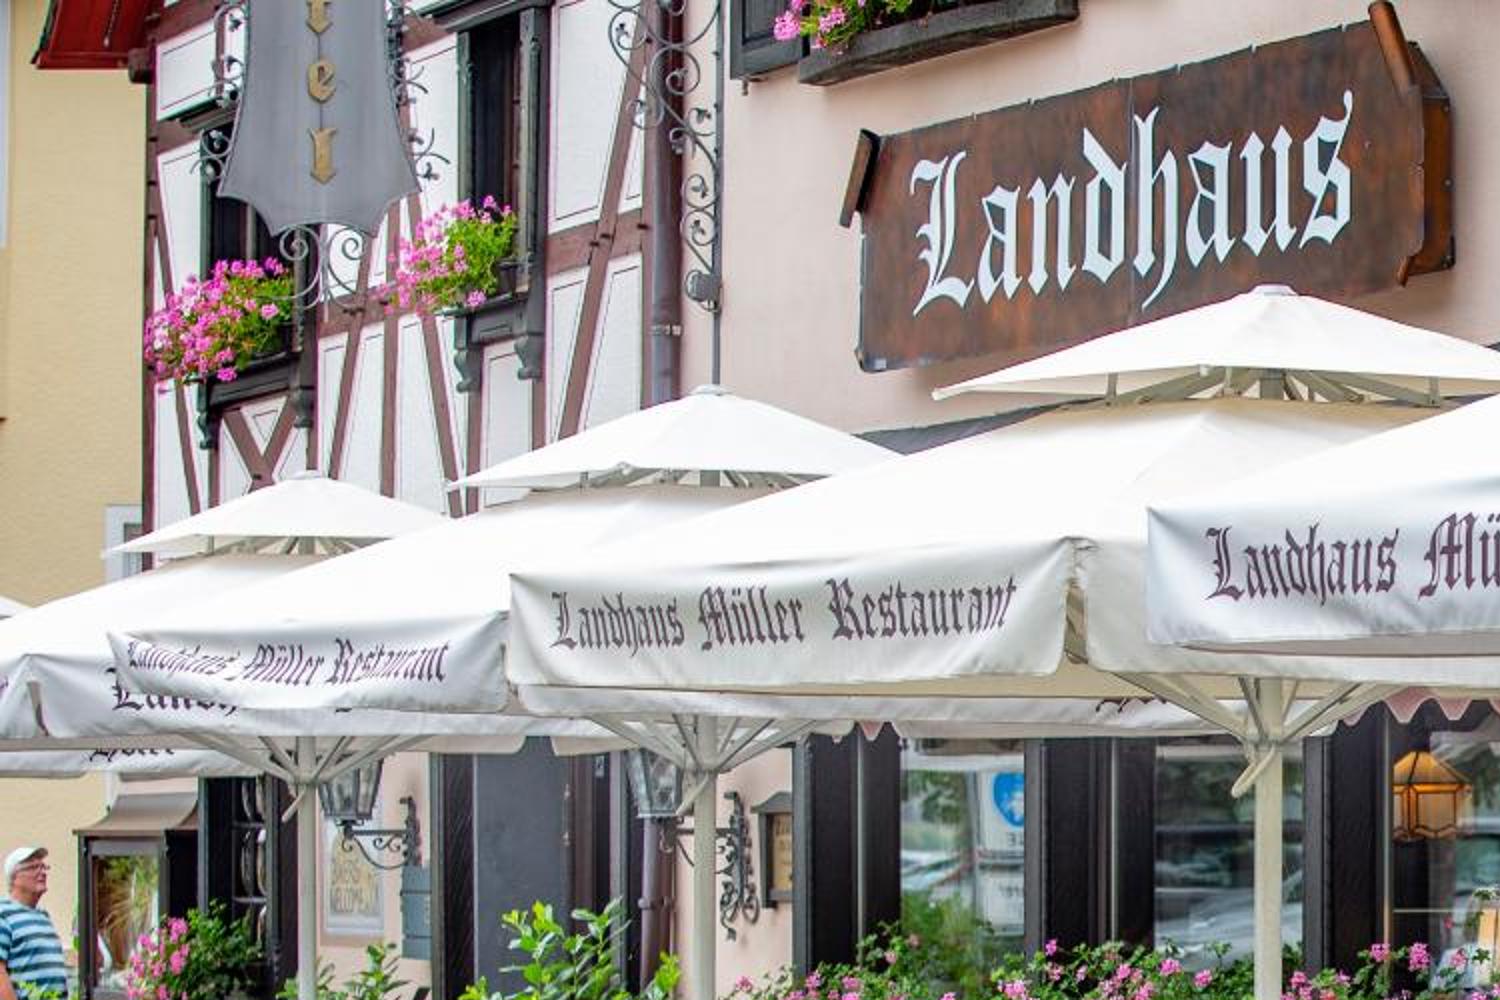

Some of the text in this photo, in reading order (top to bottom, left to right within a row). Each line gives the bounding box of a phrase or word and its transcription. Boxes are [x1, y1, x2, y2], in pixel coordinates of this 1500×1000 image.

[910, 89, 1354, 316] Landhaus
[1205, 522, 1400, 606] Landhaus
[550, 574, 1018, 658] Landhaus Müller Restaurant
[243, 643, 325, 686] Müller
